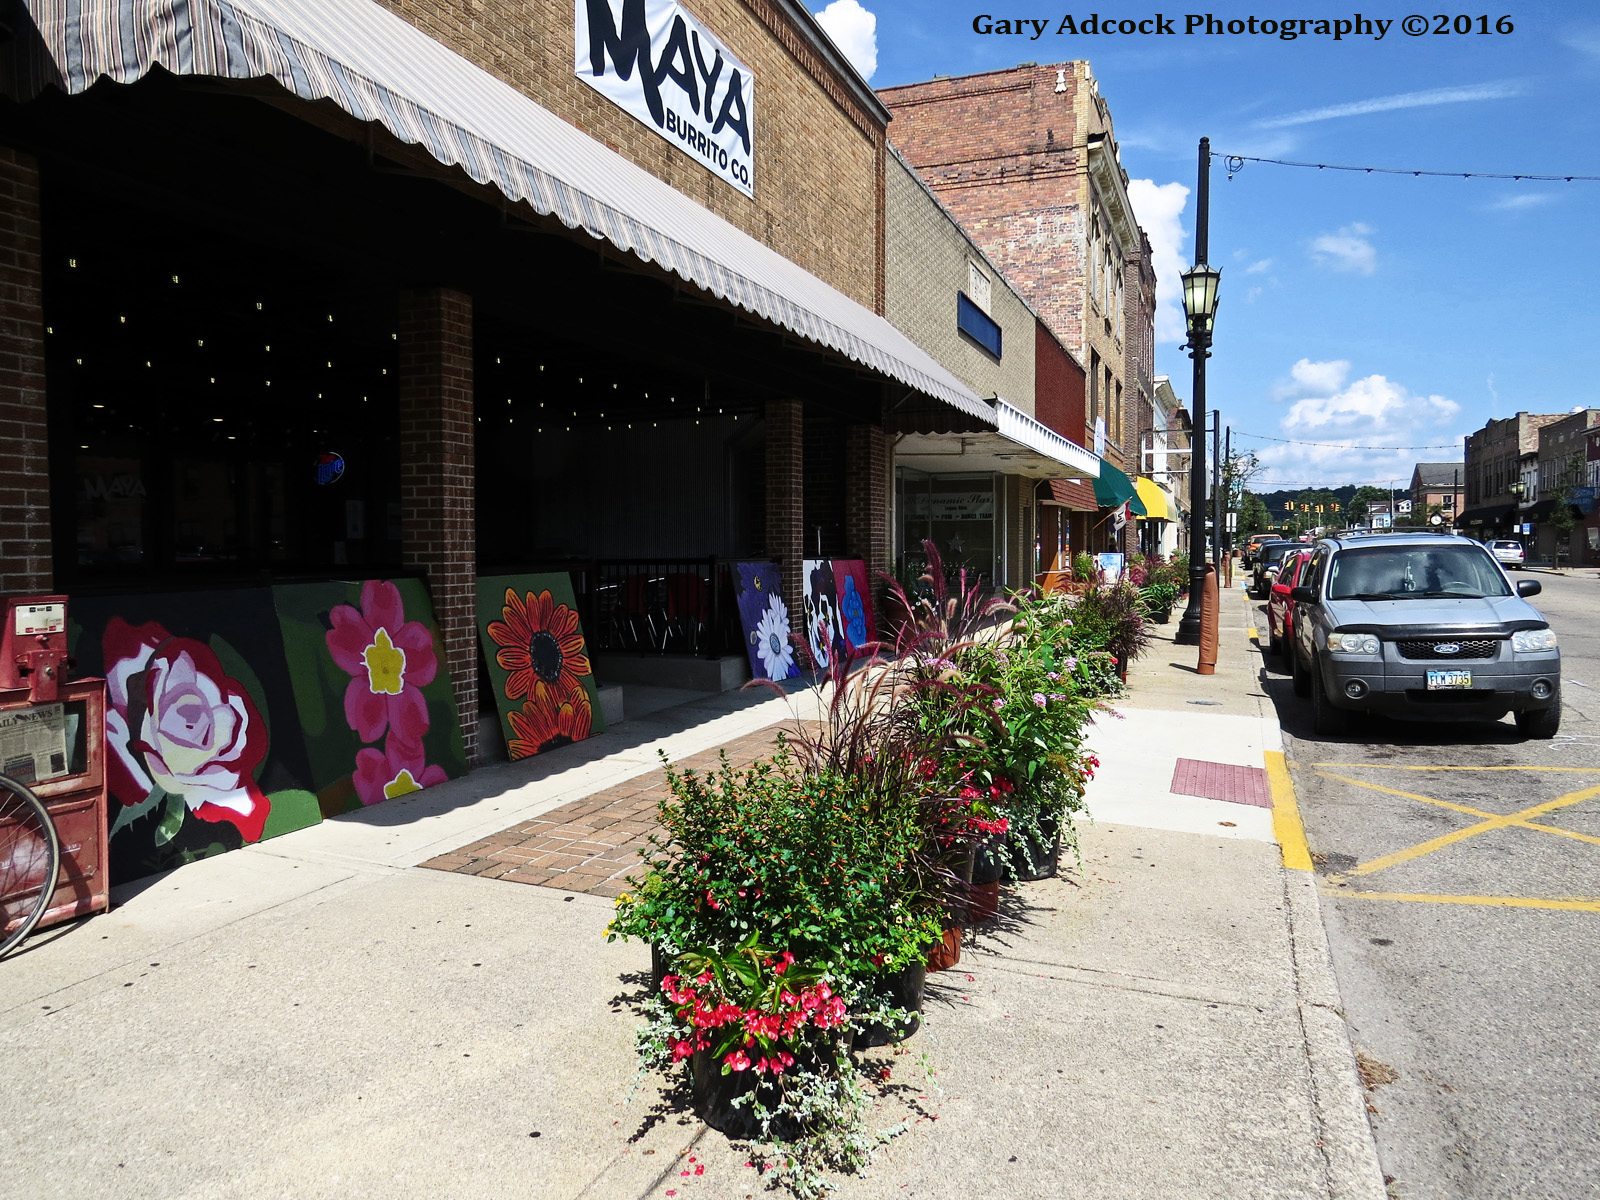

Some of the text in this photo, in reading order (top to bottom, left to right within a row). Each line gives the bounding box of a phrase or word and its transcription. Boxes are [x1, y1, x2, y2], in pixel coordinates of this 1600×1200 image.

[586, 0, 751, 157] MAYA
[666, 107, 751, 189] BURRITO CO.
[83, 475, 147, 502] MAYA
[1430, 674, 1469, 684] FLM 3735
[24, 709, 53, 721] NEWS
